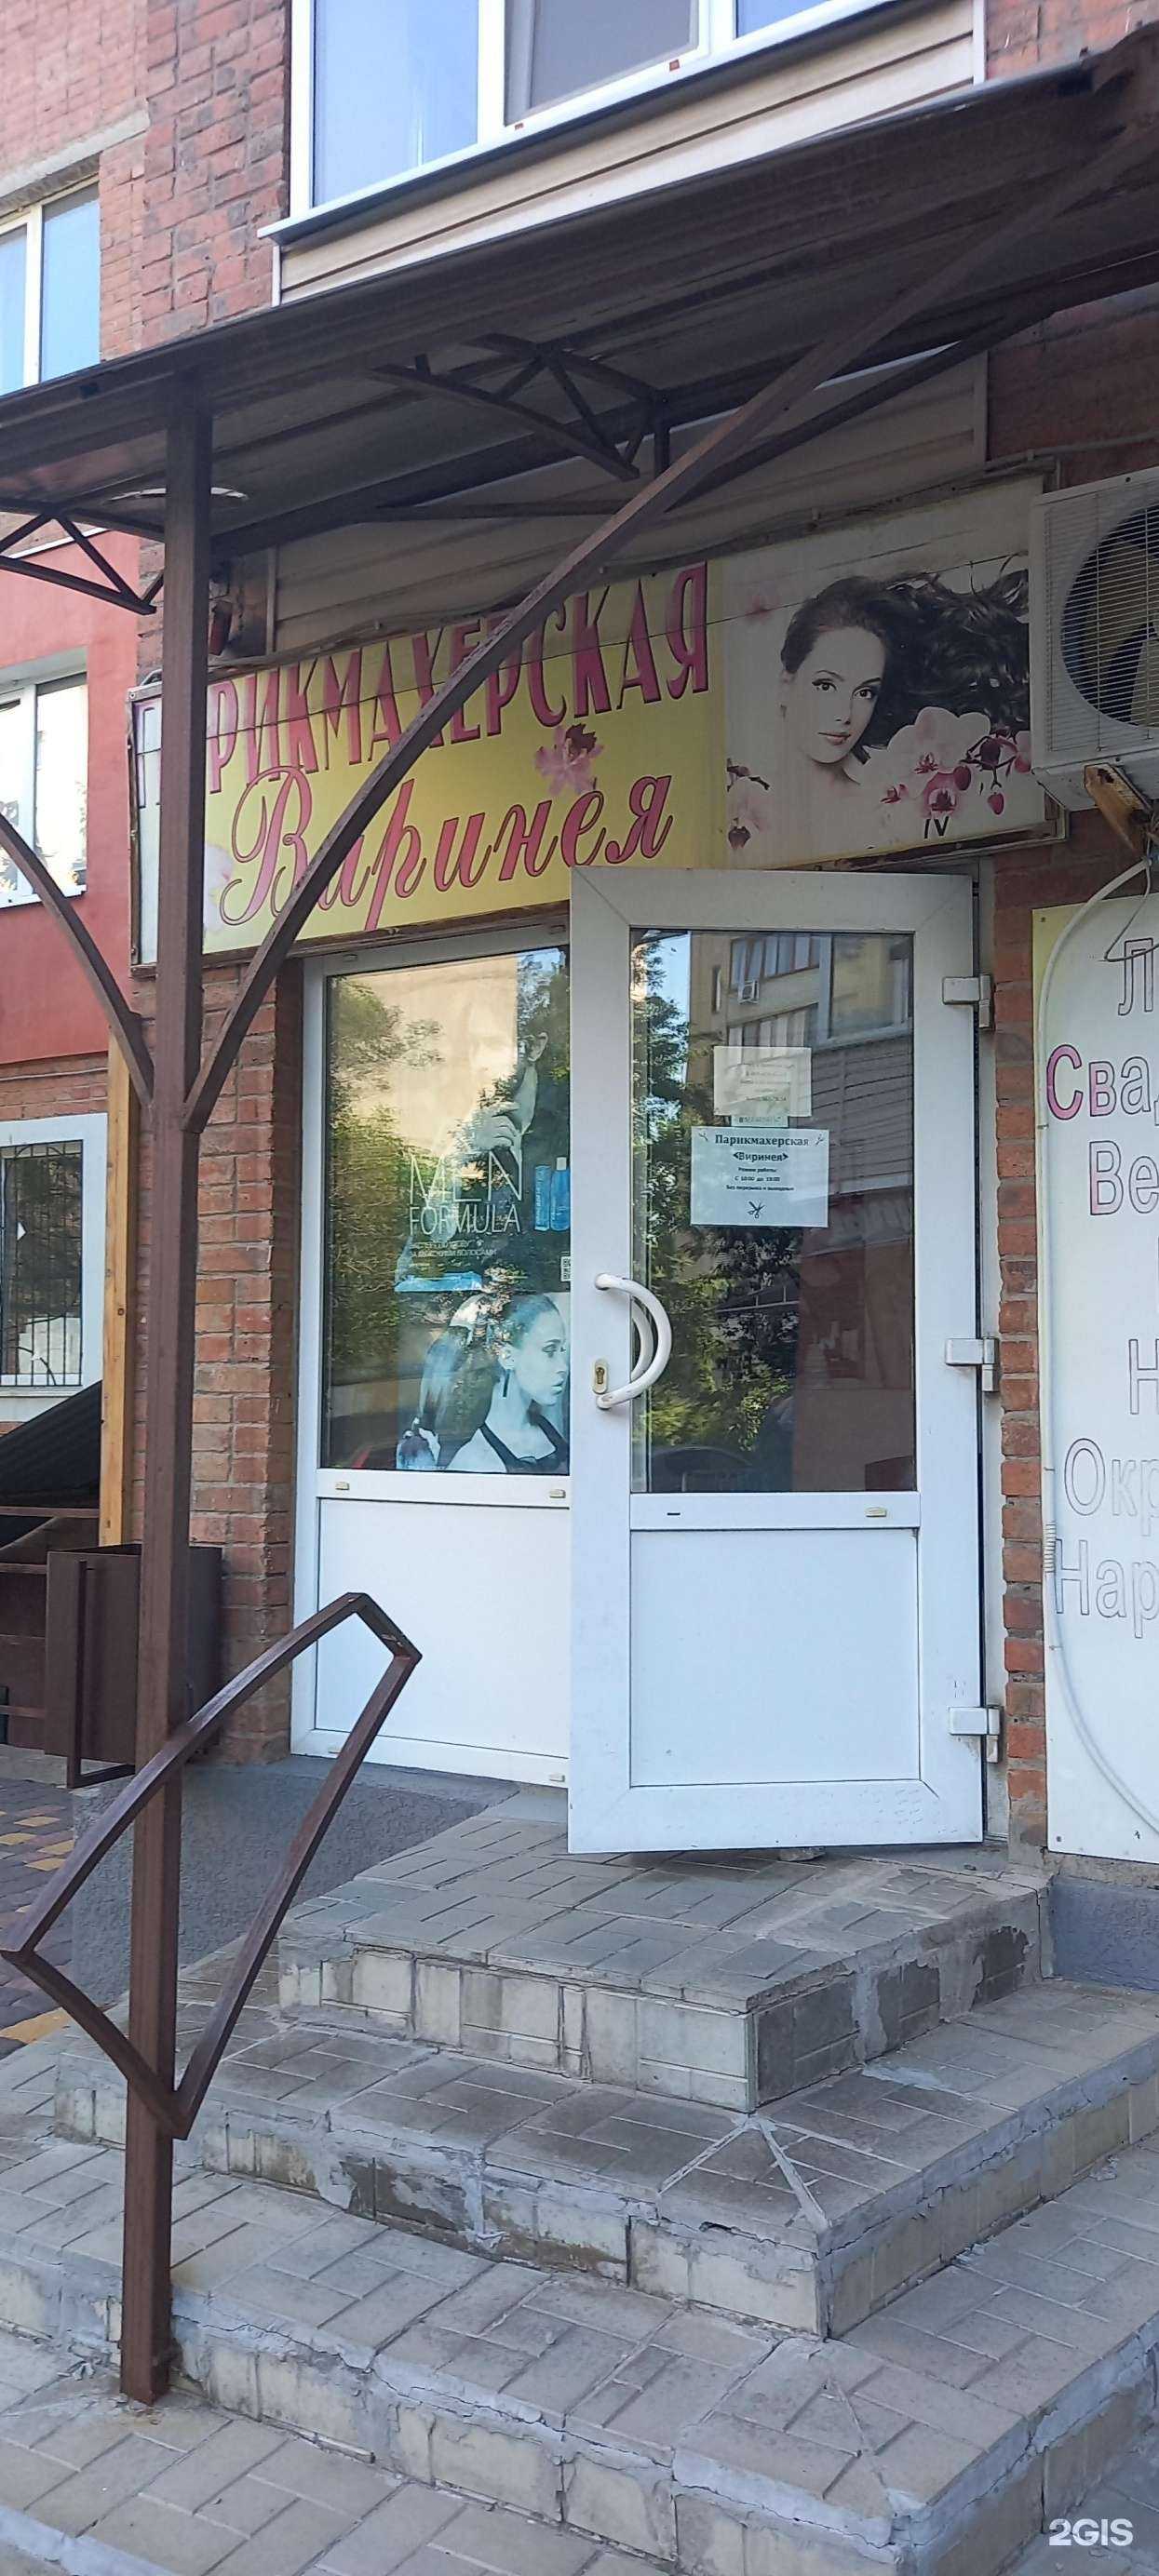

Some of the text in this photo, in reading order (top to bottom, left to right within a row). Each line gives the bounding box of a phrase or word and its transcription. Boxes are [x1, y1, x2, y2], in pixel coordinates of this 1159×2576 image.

[133, 561, 708, 808] ПРИКМАХЕРСКАЯ
[1046, 1044, 1159, 1126] Сва
[715, 1134, 809, 1147] Парикмахерская
[410, 1150, 523, 1204] MEN
[410, 1204, 521, 1236] FORMULA
